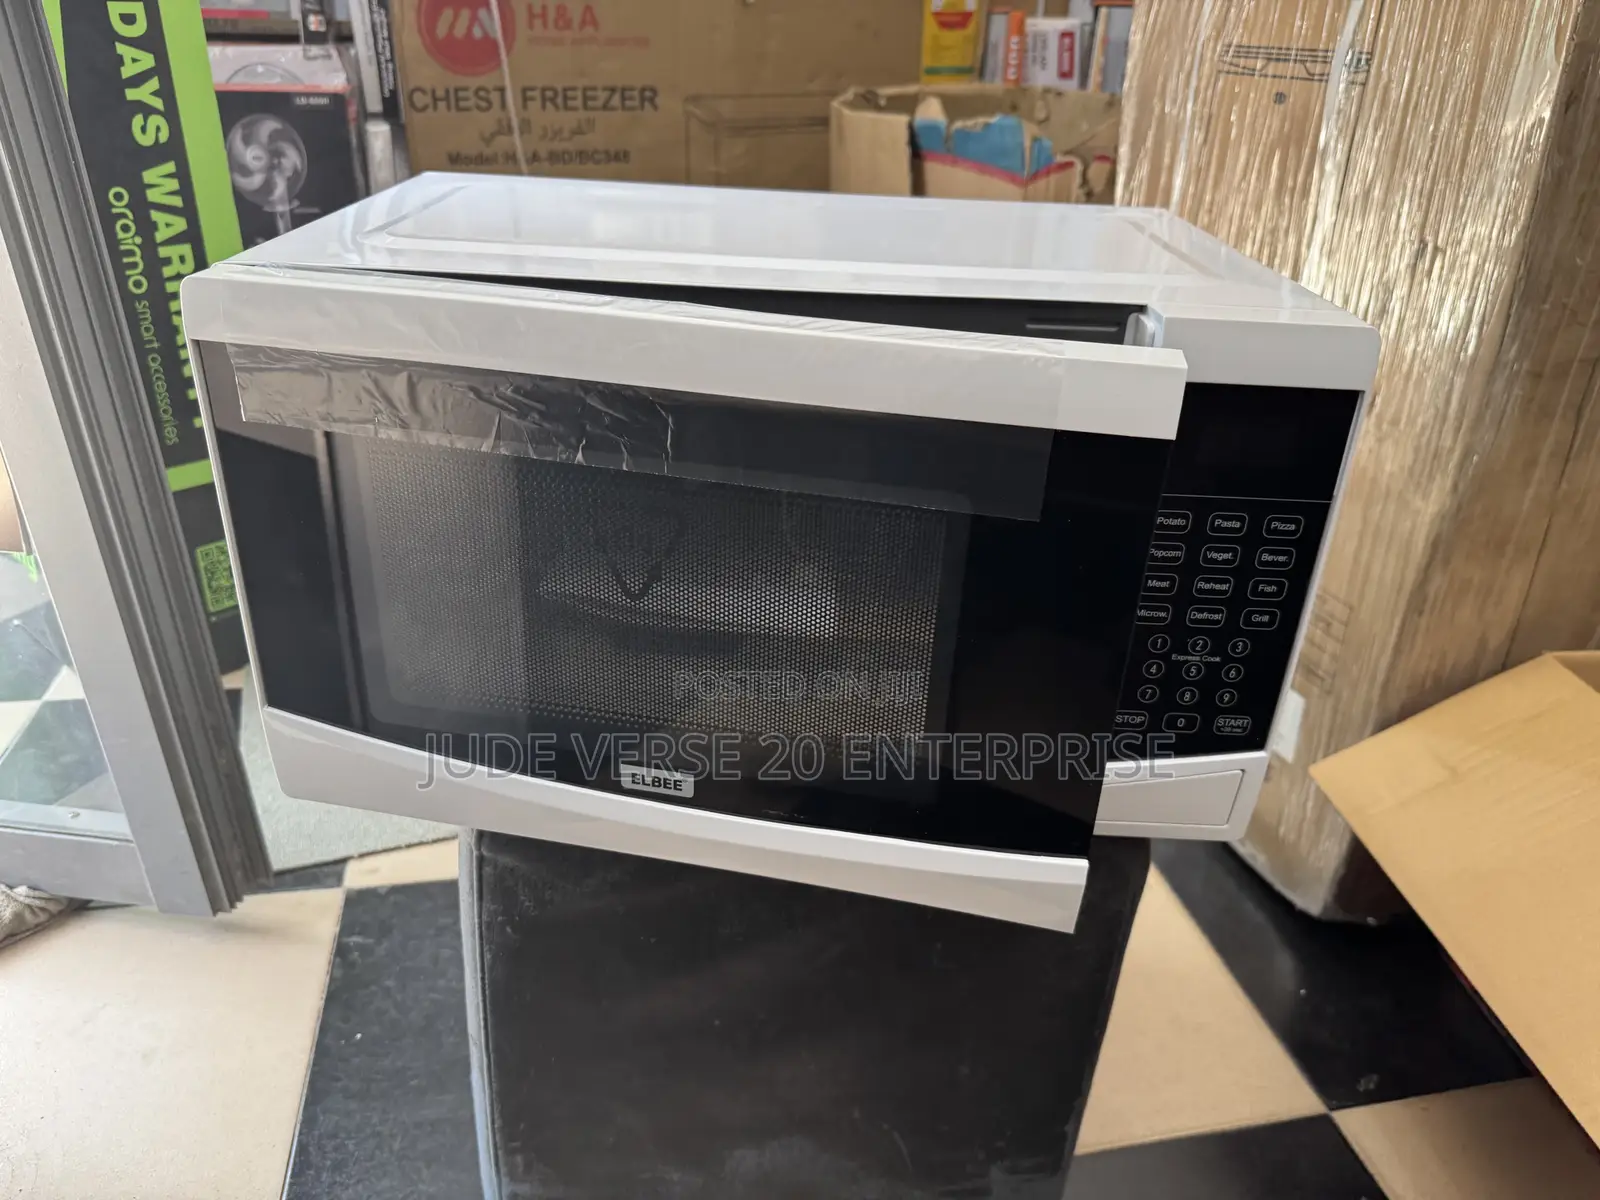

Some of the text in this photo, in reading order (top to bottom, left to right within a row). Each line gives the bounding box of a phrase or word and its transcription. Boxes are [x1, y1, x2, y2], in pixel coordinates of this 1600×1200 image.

[527, 4, 600, 31] H&A
[106, 1, 170, 147] DAYS
[408, 86, 659, 113] CHEST FREEZER
[108, 186, 148, 295] oraimo
[134, 300, 161, 350] smart
[148, 353, 180, 446] accessories
[1156, 516, 1186, 526] Potato
[1214, 519, 1241, 528] Pasta
[1270, 521, 1295, 531] Pizza
[1206, 551, 1234, 561] Veget.
[1261, 553, 1289, 562] Bever.
[1147, 579, 1170, 588] Meat
[1197, 581, 1229, 591] Reheat
[1258, 584, 1277, 592] Fish
[1190, 611, 1223, 620] Defrost
[1251, 614, 1269, 623] Grill
[1156, 638, 1162, 649] 1
[1195, 640, 1203, 651] 2
[1235, 641, 1243, 652] 3
[1172, 654, 1200, 662] Express
[1149, 665, 1157, 674] 4
[1189, 666, 1197, 676] 5
[1229, 668, 1236, 678] 6
[1145, 689, 1152, 700] 7
[1183, 691, 1191, 701] 8
[1223, 693, 1231, 703] 9
[1115, 715, 1145, 724] STOP
[1177, 717, 1185, 727] 0
[1217, 718, 1249, 727] START
[631, 772, 683, 791] ELBEE
